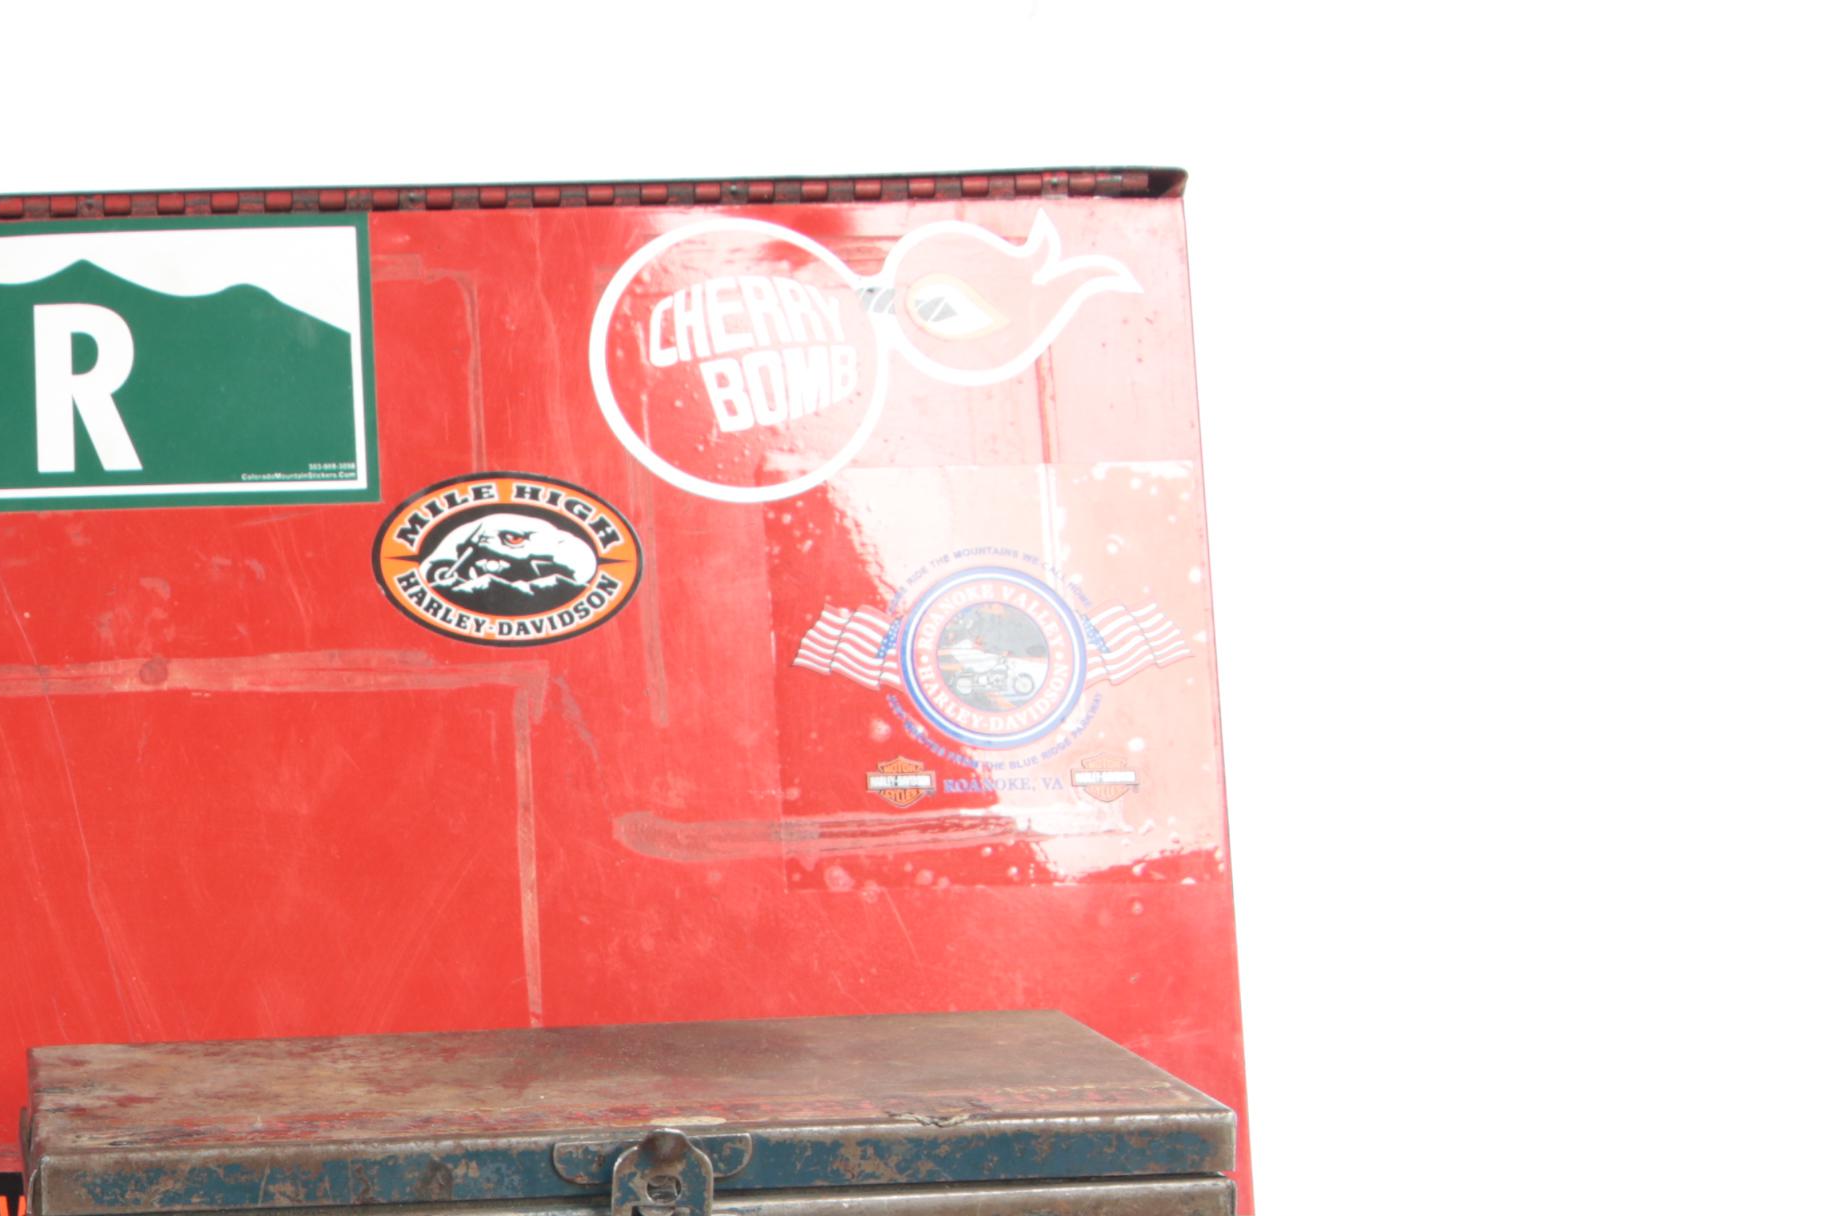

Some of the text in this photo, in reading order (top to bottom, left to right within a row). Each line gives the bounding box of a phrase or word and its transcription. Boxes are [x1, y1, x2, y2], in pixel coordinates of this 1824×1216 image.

[650, 275, 845, 367] CHERRY
[699, 345, 858, 432] BOMB
[396, 484, 622, 549] MILE HIGH
[953, 546, 1018, 560] MOUNTAINS
[396, 570, 620, 637] HARLEY-DAVIDSON
[917, 583, 994, 649] ROANOKE
[1001, 585, 1064, 648] VALLEY
[917, 663, 1069, 731] HARLEY-DAVIDSON
[1042, 777, 1064, 790] VA
